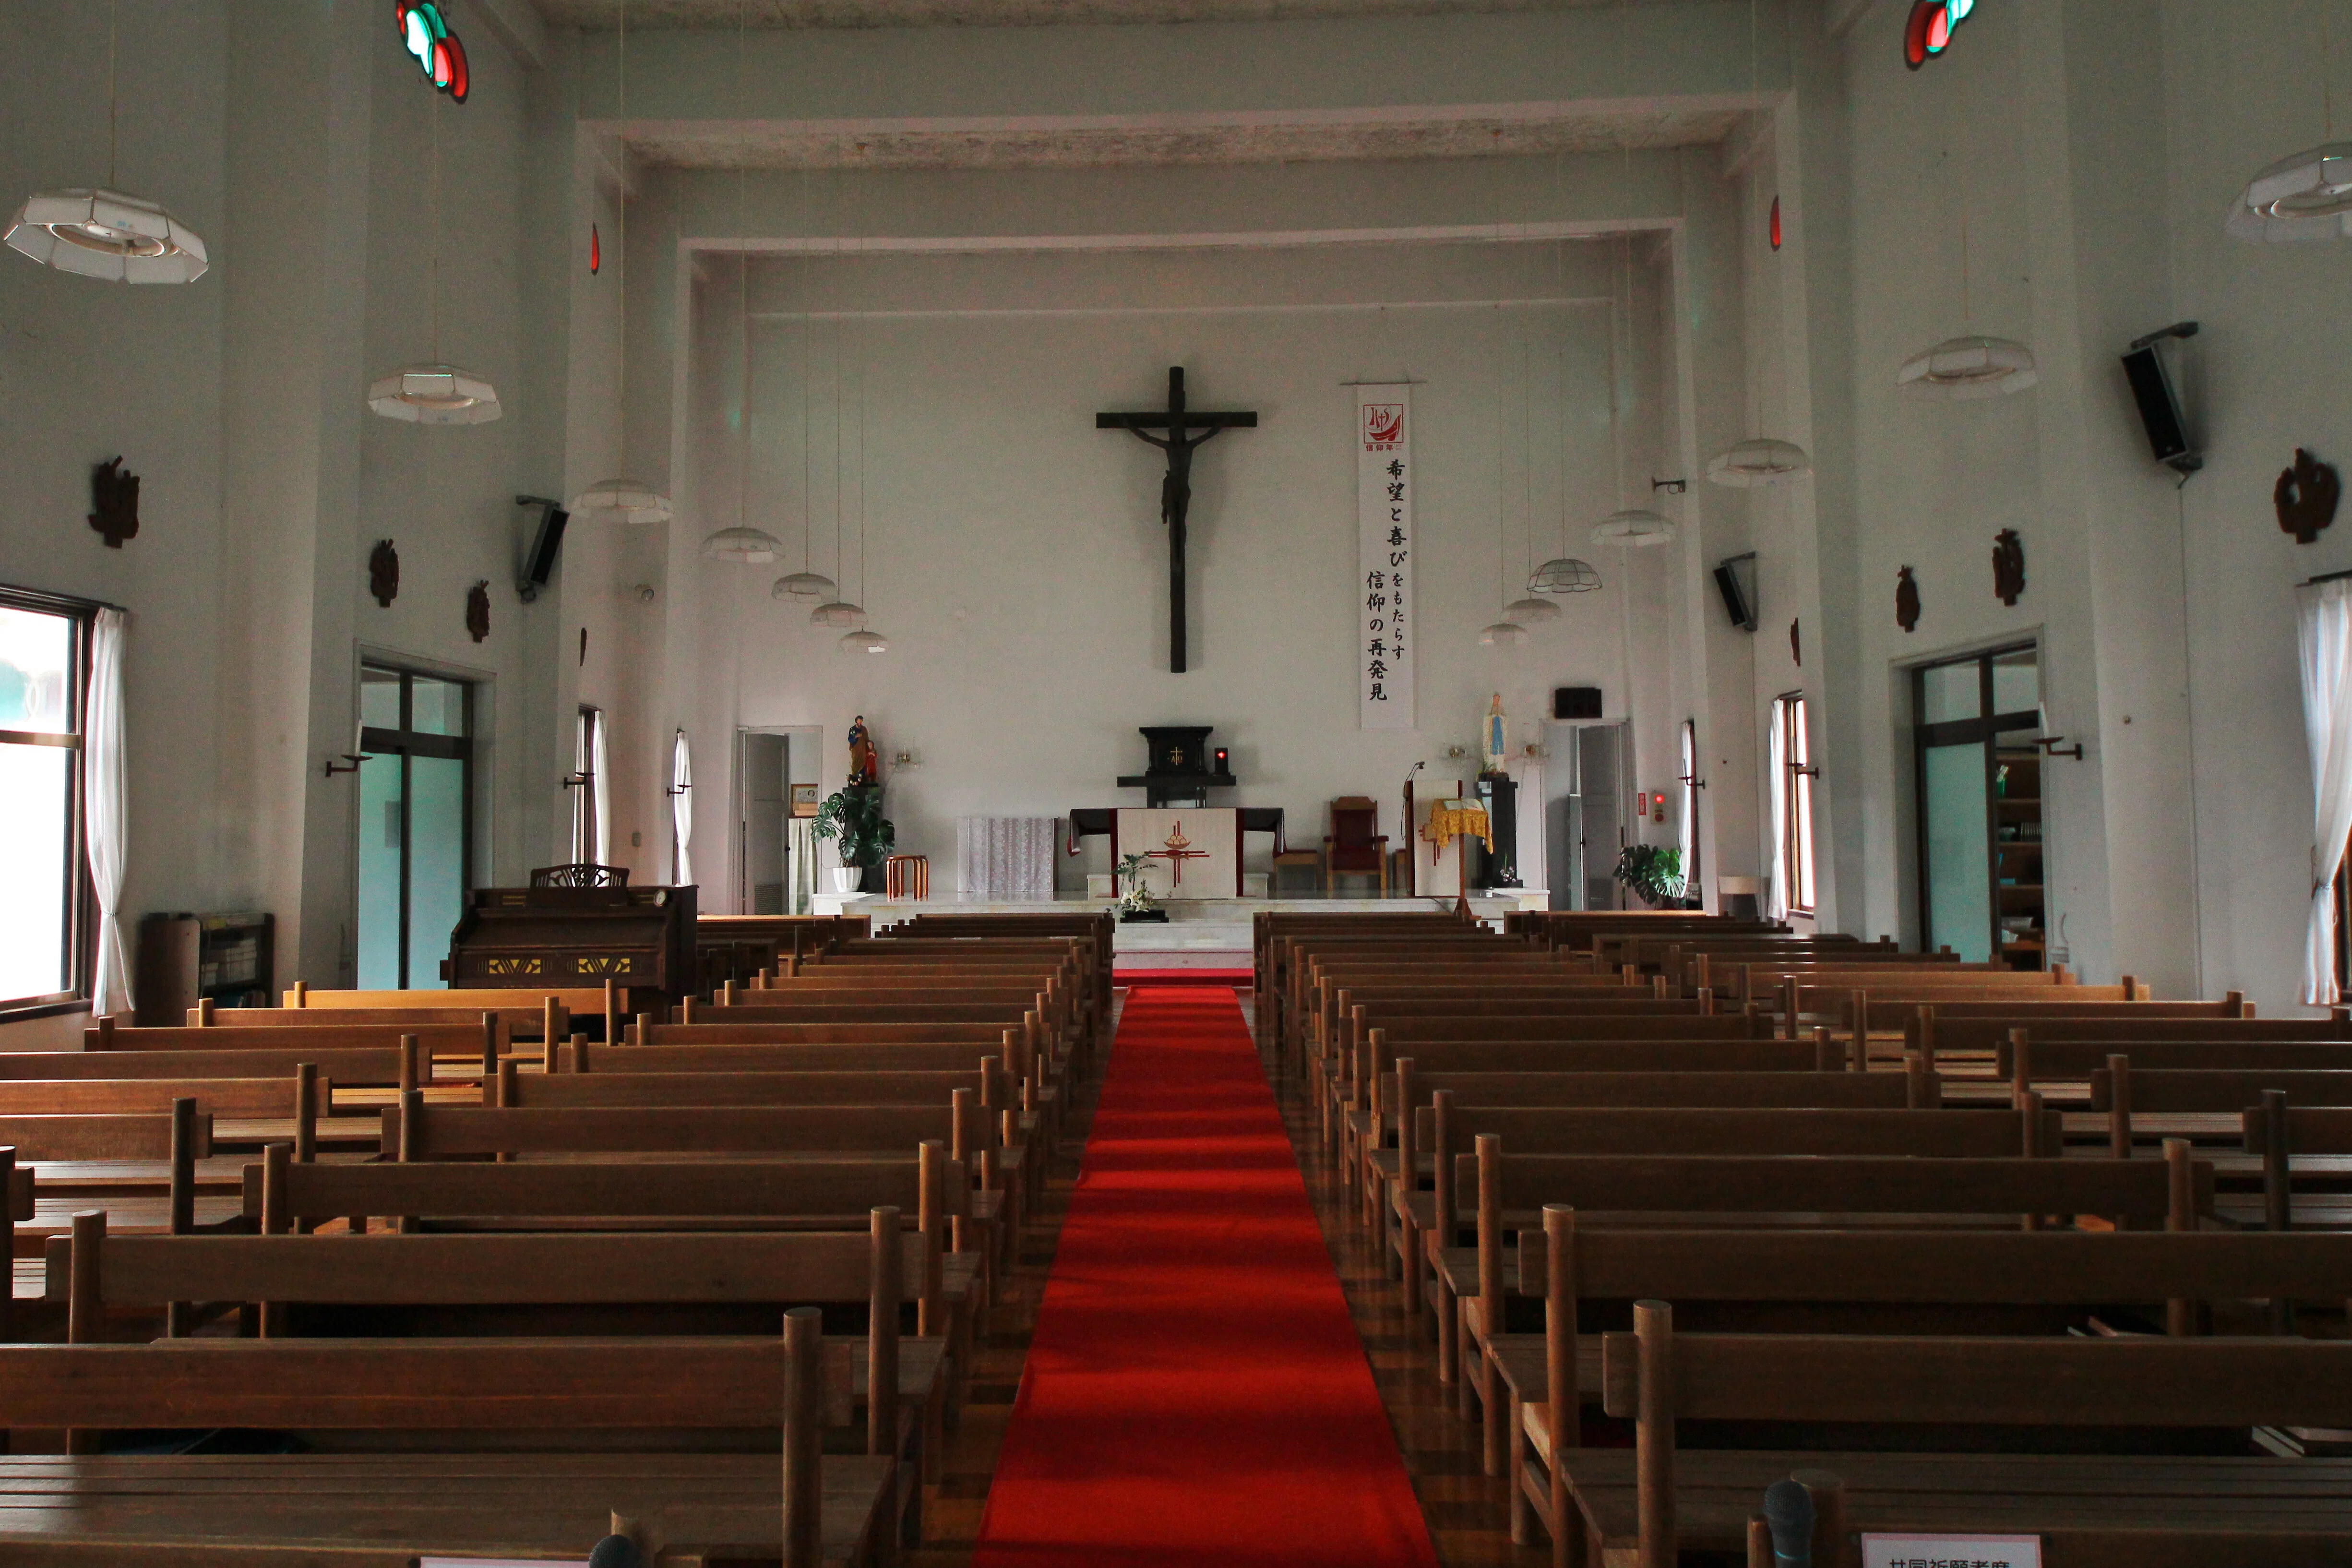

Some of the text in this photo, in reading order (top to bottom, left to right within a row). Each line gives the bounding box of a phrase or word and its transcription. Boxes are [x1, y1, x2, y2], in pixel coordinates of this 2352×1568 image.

[1366, 571, 1388, 701] 信仰の再発見
[1386, 459, 1408, 660] 希望と喜びをもたらす
